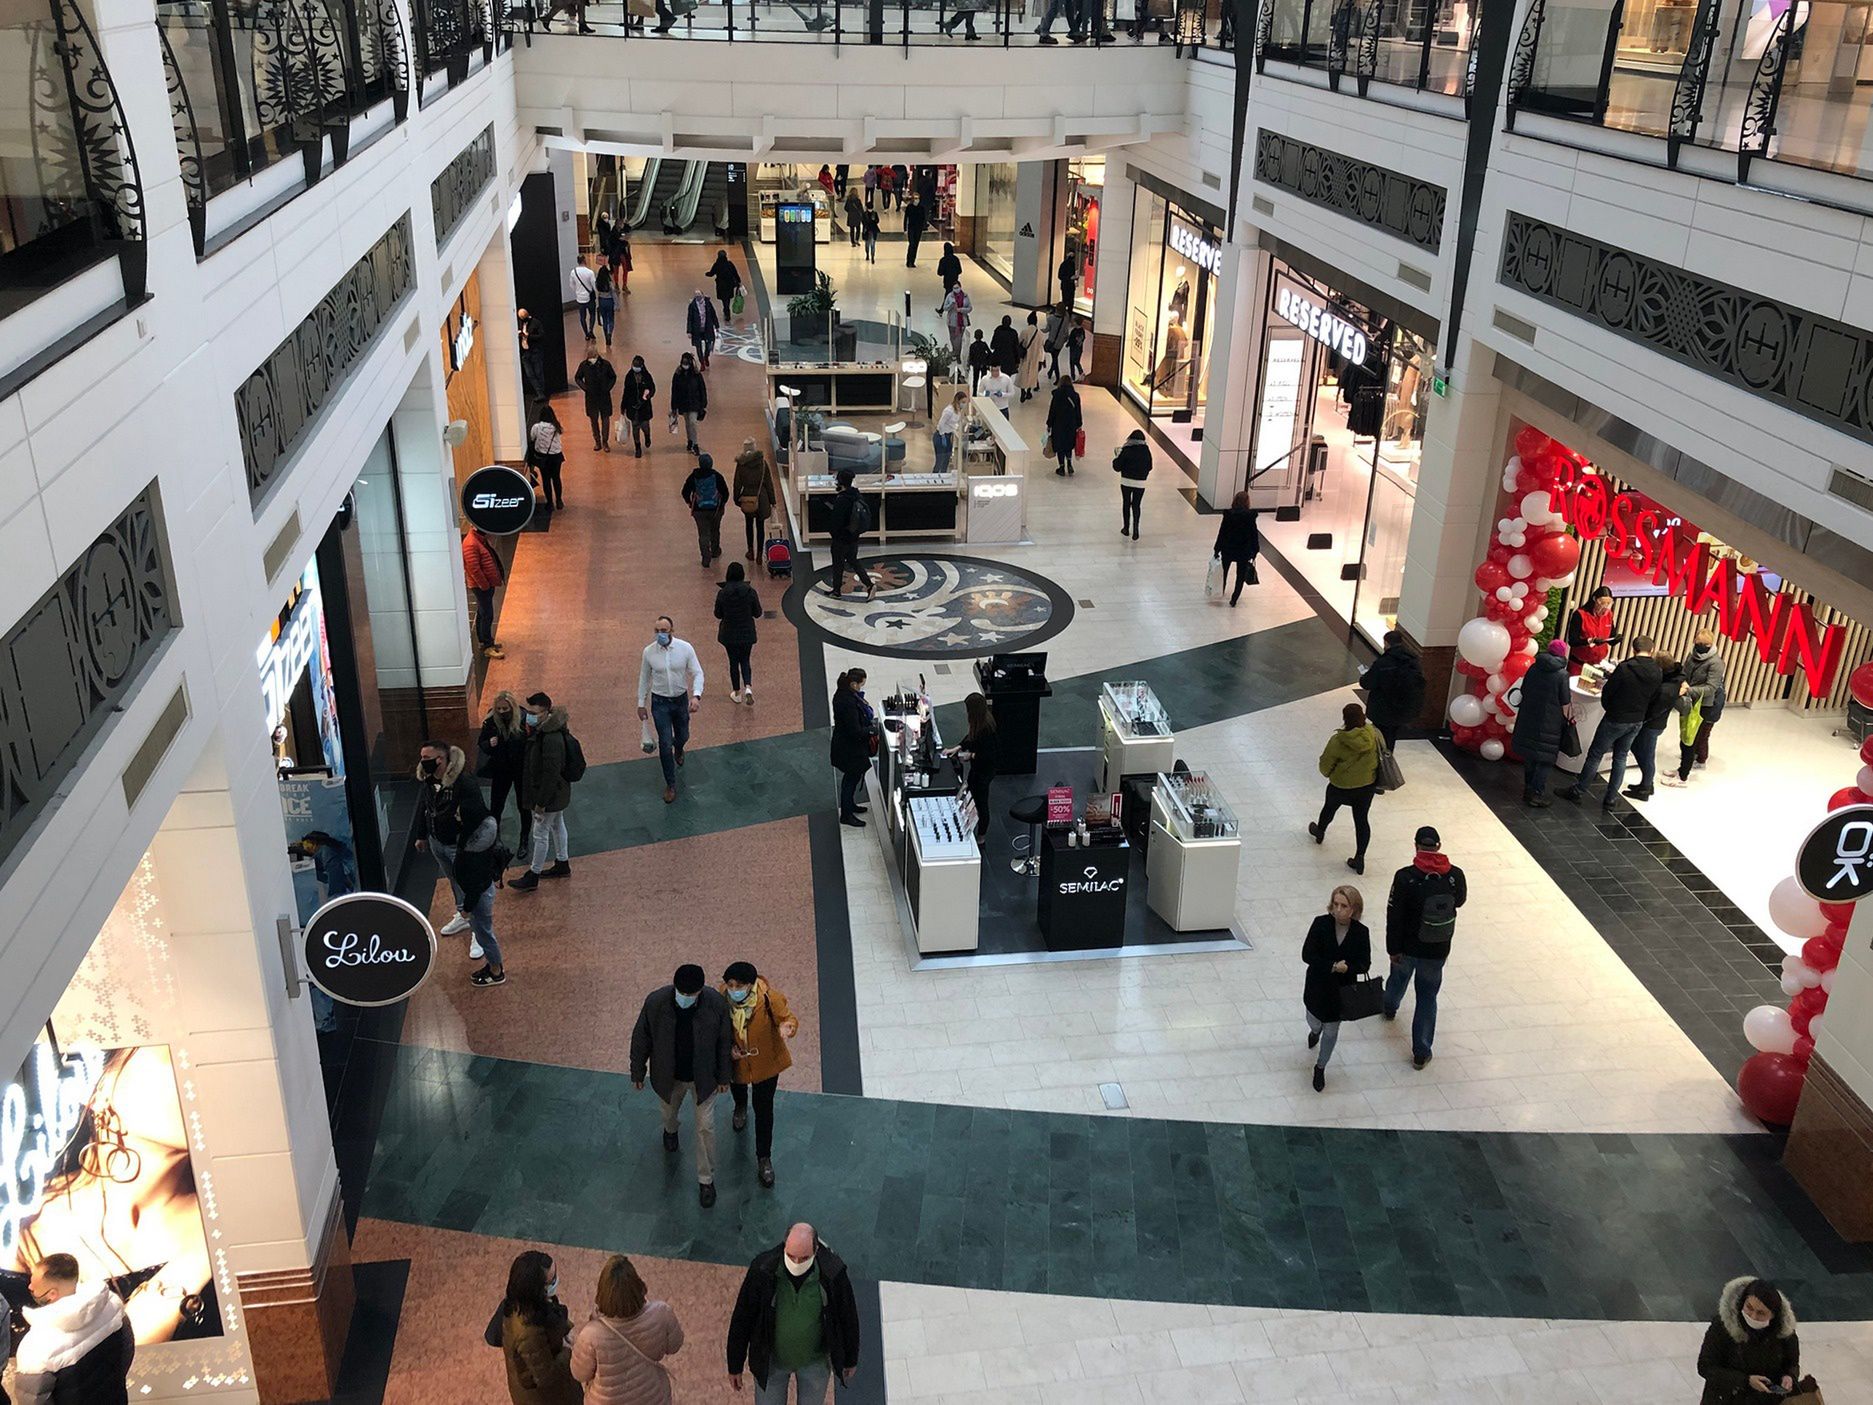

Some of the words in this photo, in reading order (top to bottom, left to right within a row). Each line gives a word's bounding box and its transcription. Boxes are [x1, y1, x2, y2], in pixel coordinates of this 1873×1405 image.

[1171, 224, 1221, 277] RESERVE
[1278, 288, 1367, 366] RESERVED
[472, 493, 525, 509] Sizeer
[974, 484, 1018, 498] IQOS
[1549, 455, 1846, 698] ROSSMANN
[1060, 880, 1121, 894] SEMILAC
[323, 930, 416, 968] Lilou
